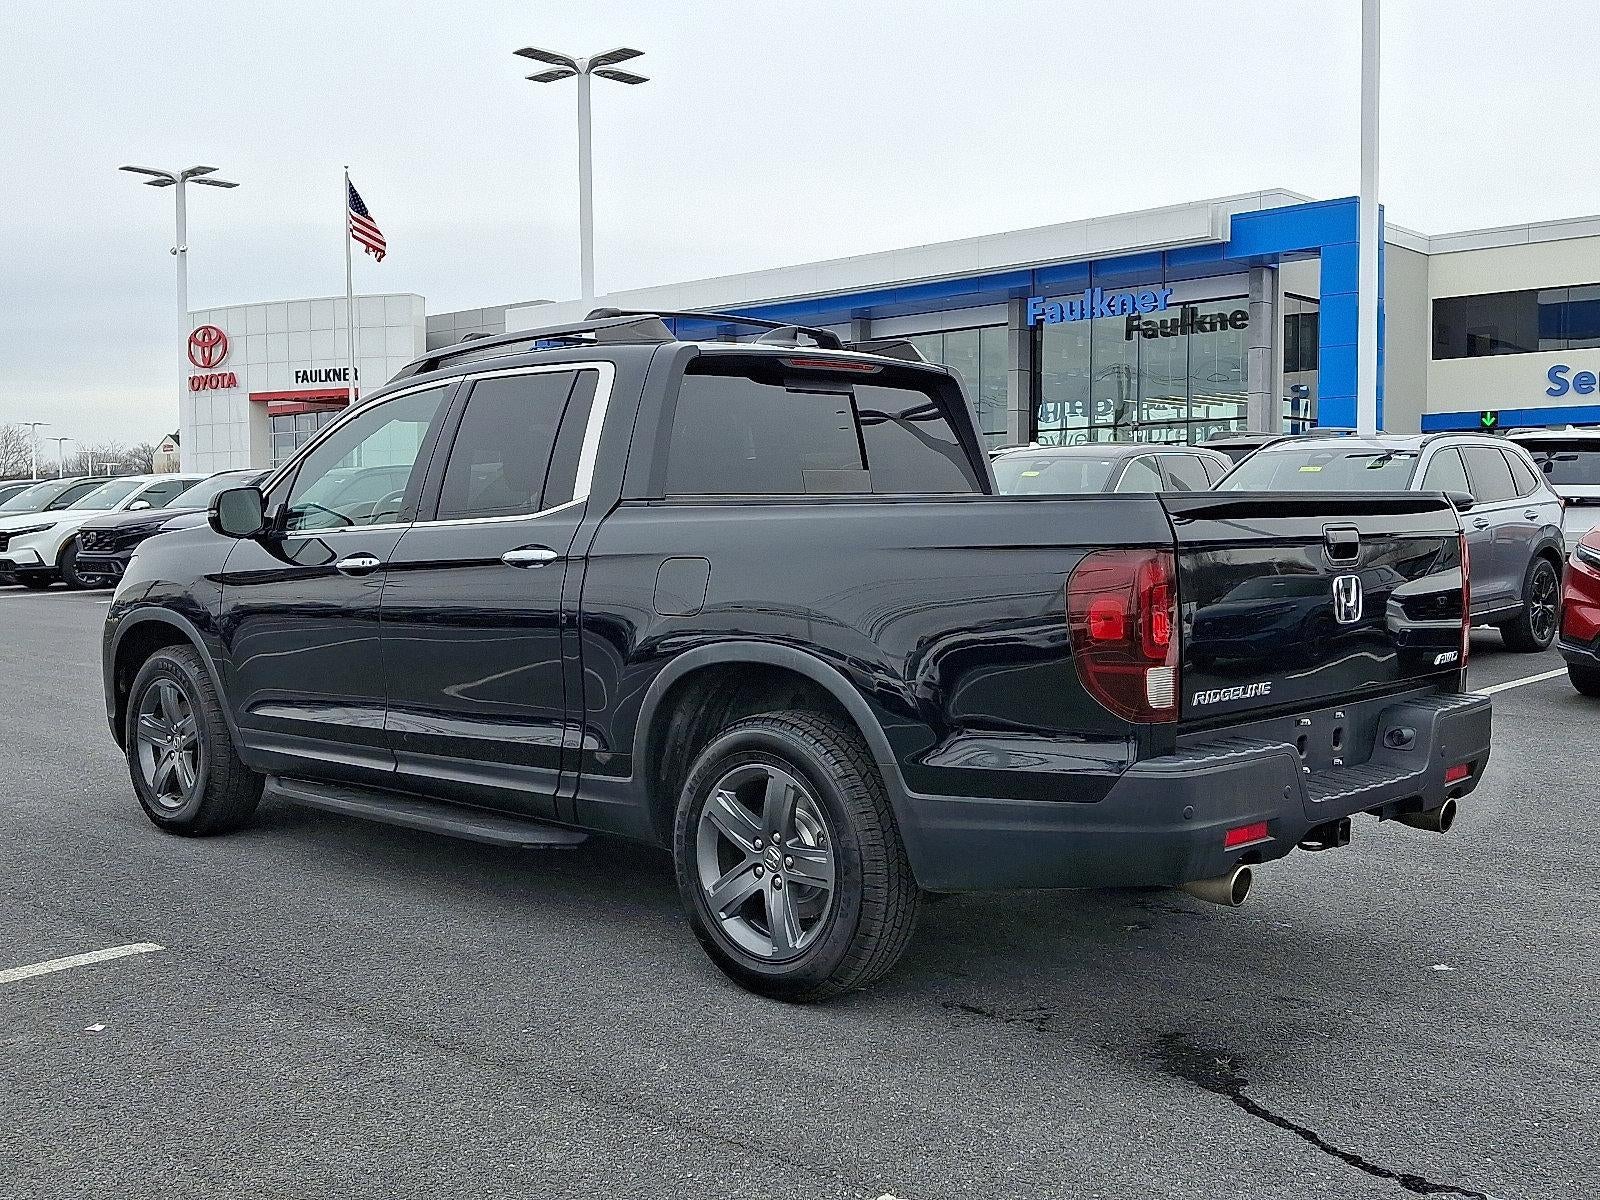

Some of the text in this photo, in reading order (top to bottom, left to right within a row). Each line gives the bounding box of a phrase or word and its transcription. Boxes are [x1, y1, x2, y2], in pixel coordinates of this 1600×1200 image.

[1027, 286, 1173, 327] Faulkner
[1124, 304, 1250, 341] Faulkne
[188, 371, 237, 391] OYOTA
[1545, 364, 1600, 397] Se
[1191, 681, 1273, 707] RIDGELINE
